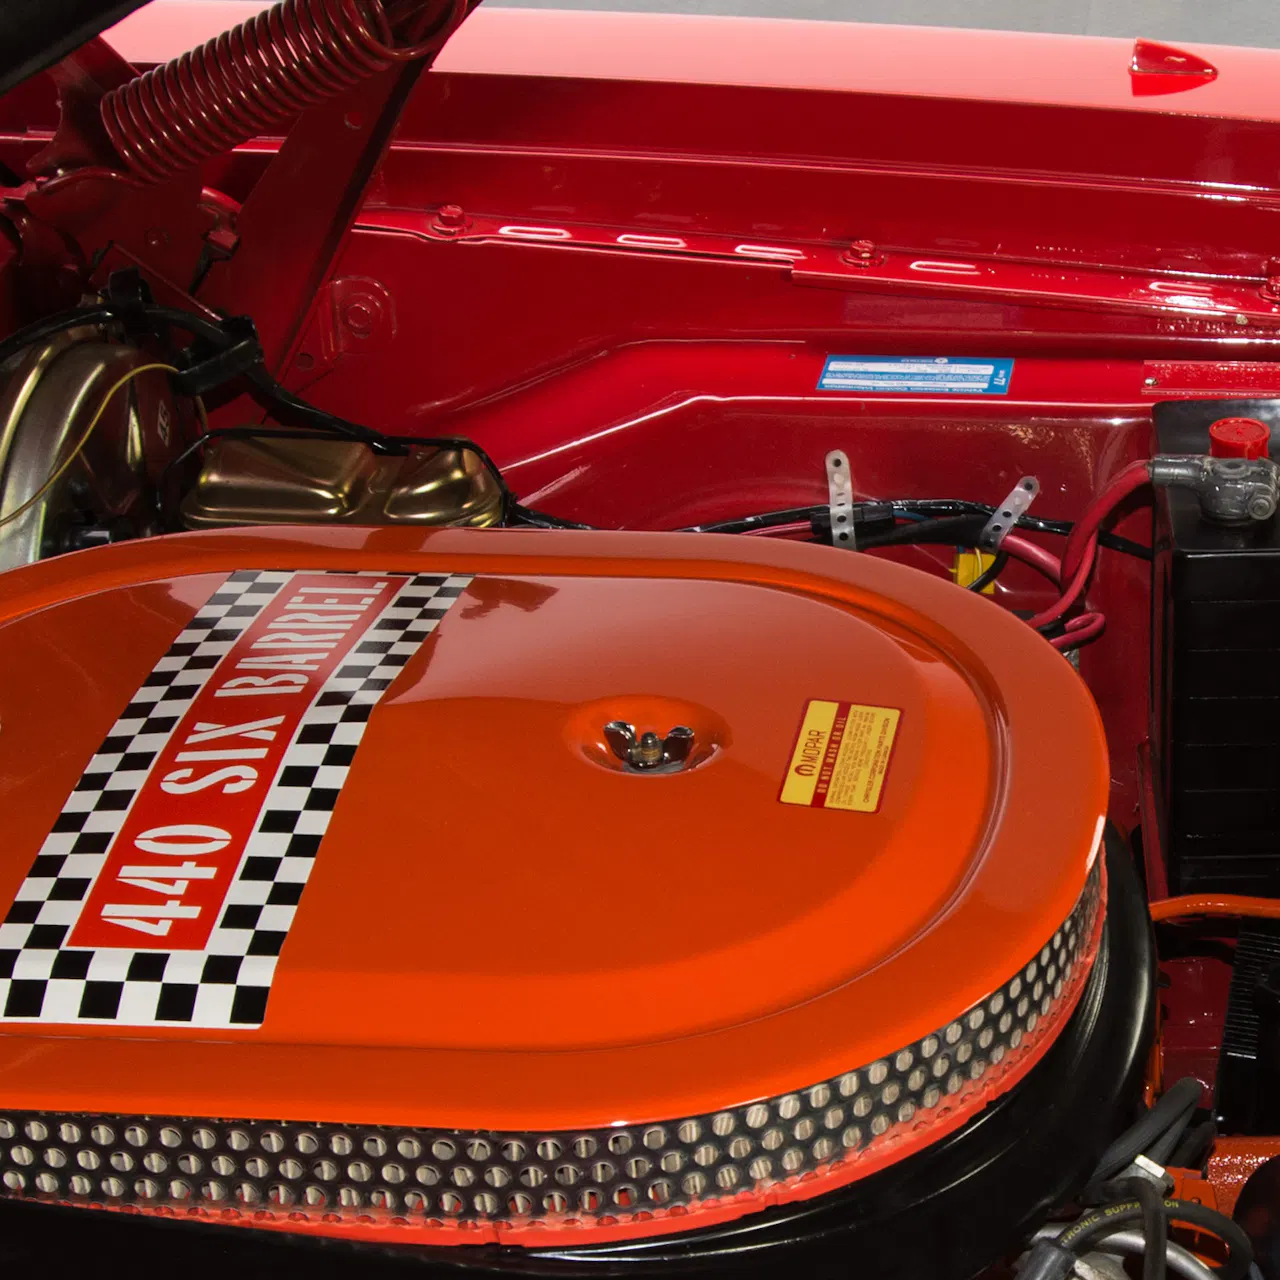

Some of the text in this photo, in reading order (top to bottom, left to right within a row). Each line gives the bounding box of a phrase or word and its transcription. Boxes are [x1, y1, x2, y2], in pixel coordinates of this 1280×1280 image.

[100, 581, 389, 936] 440 SIX BARREL
[800, 729, 827, 765] MOPAR
[1061, 1216, 1101, 1246] TRONIC
